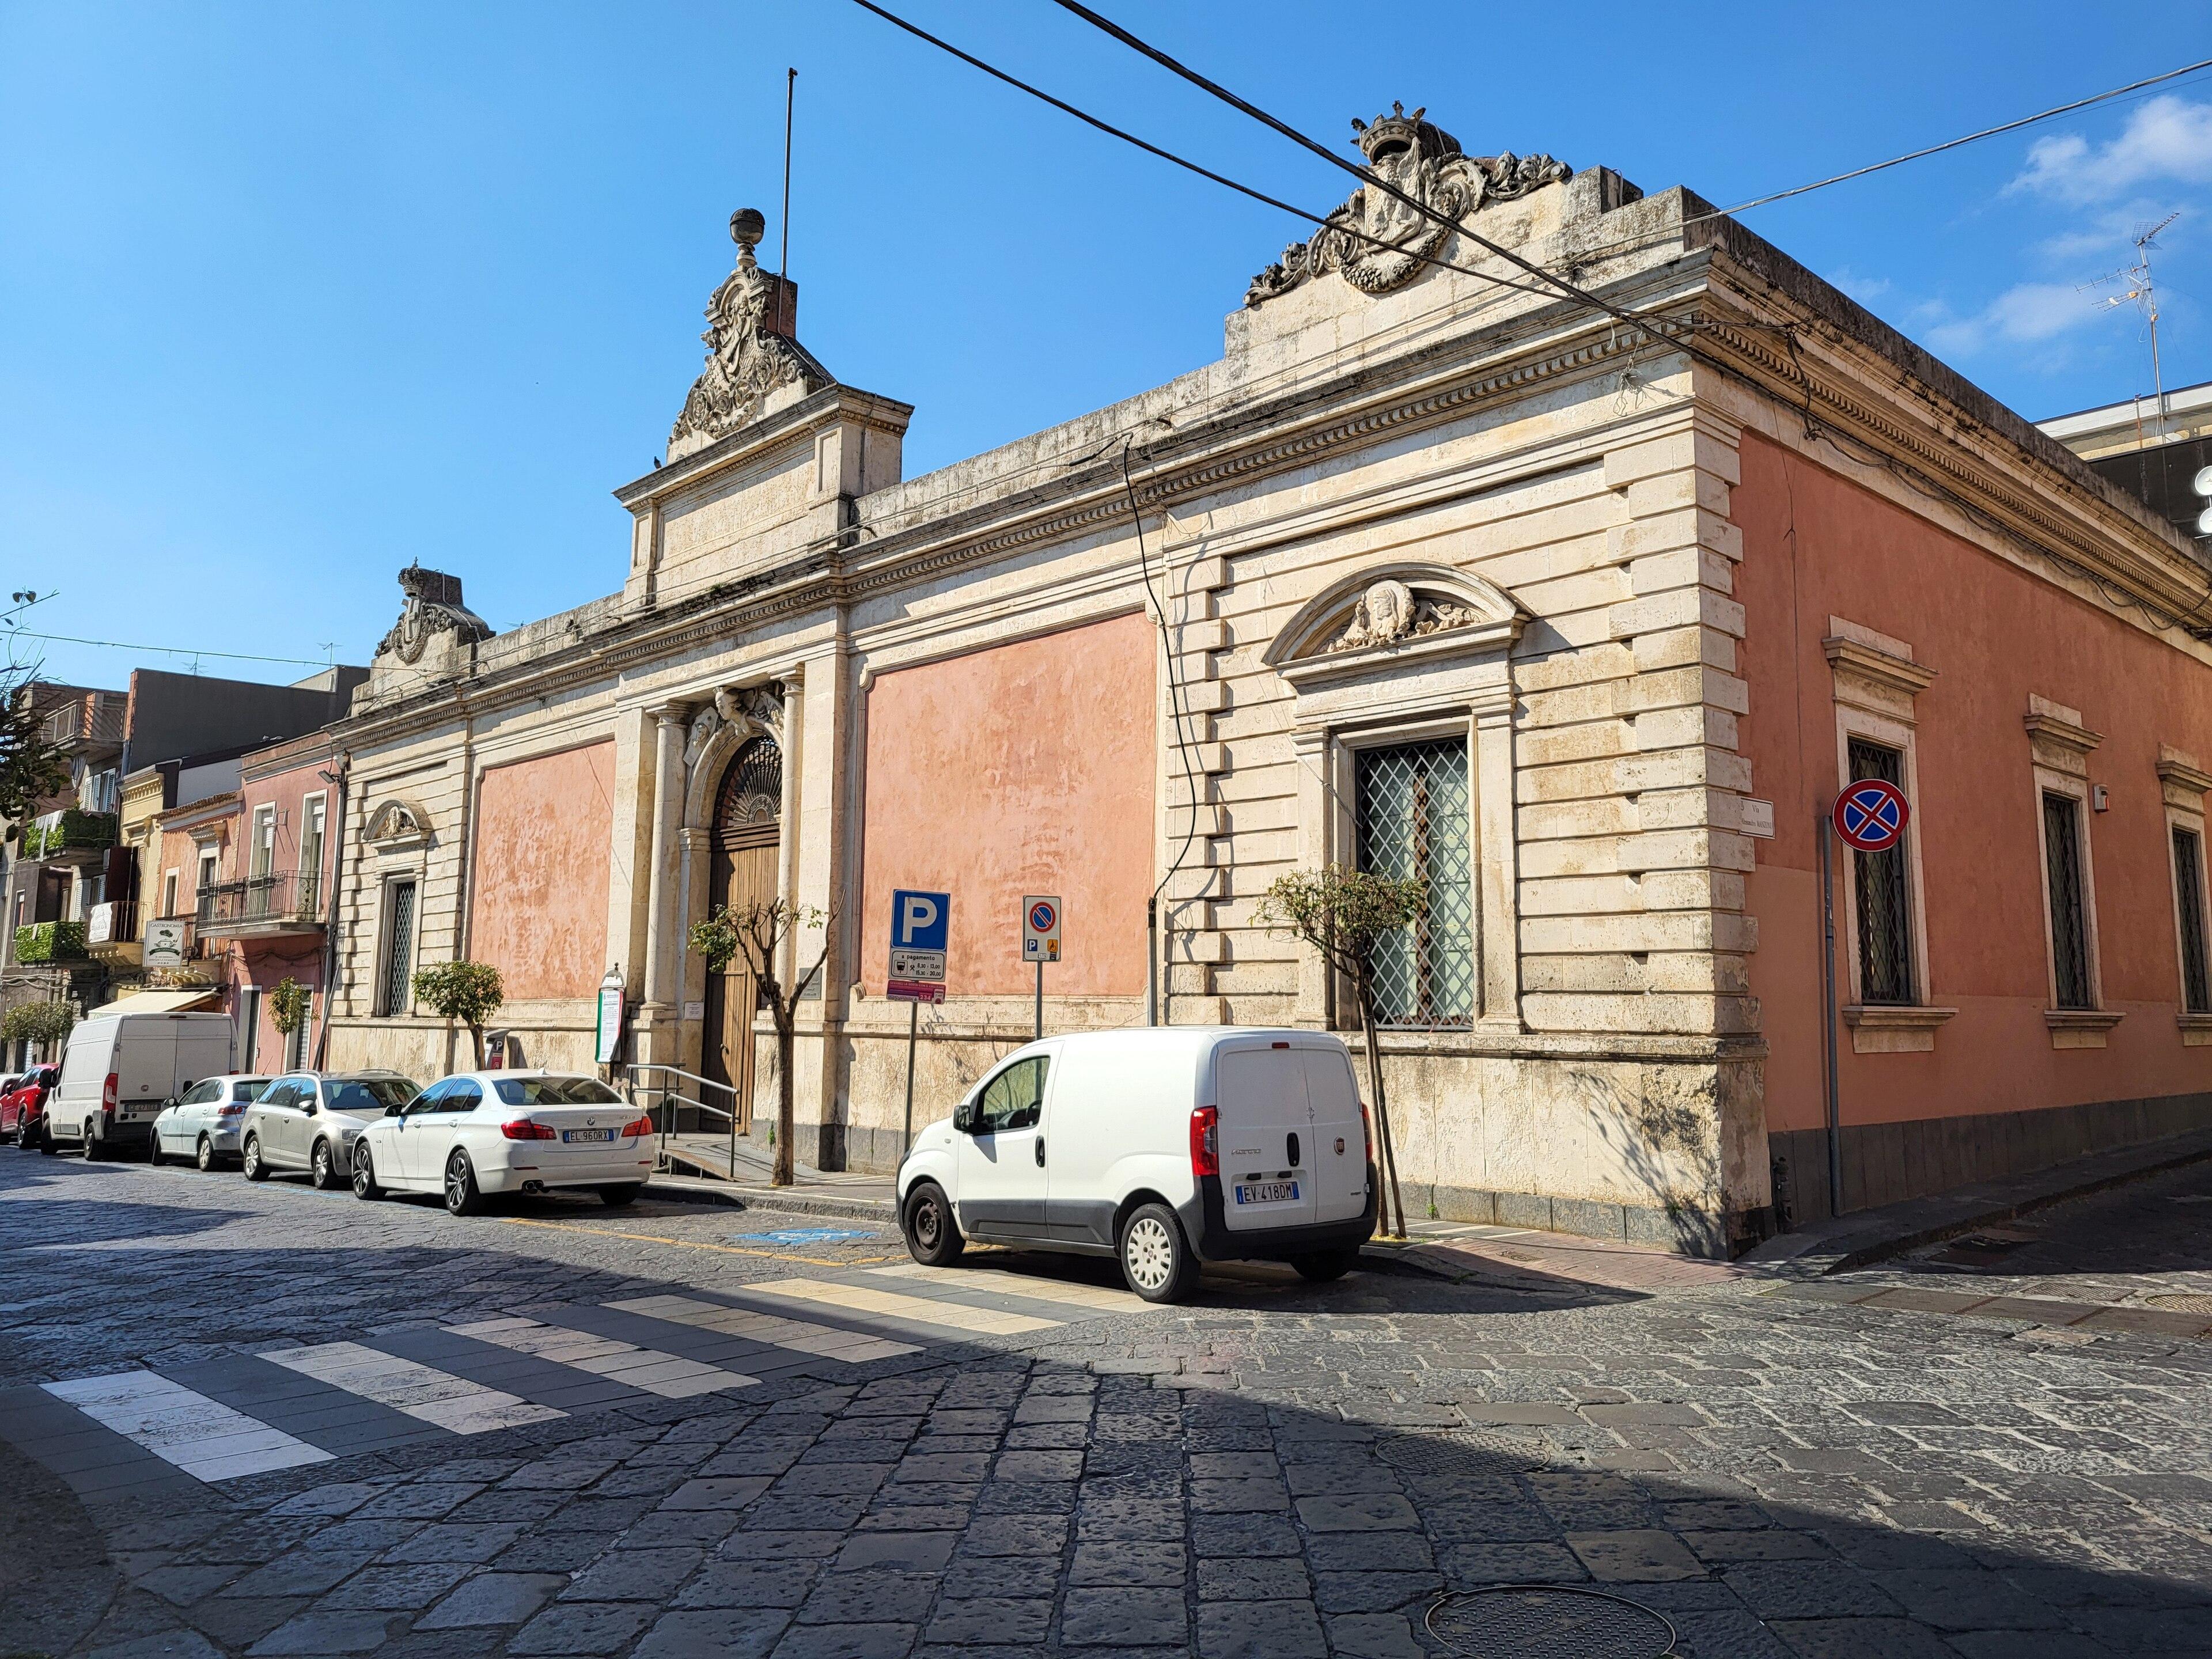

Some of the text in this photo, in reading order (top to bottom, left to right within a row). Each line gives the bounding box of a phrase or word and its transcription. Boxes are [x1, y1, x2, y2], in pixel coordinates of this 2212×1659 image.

[1752, 804, 1760, 813] Via
[902, 896, 937, 943] P
[1029, 940, 1036, 950] P
[496, 1041, 503, 1051] P
[570, 1131, 608, 1141] EL 960RX
[1244, 1182, 1293, 1201] EV 418DM
